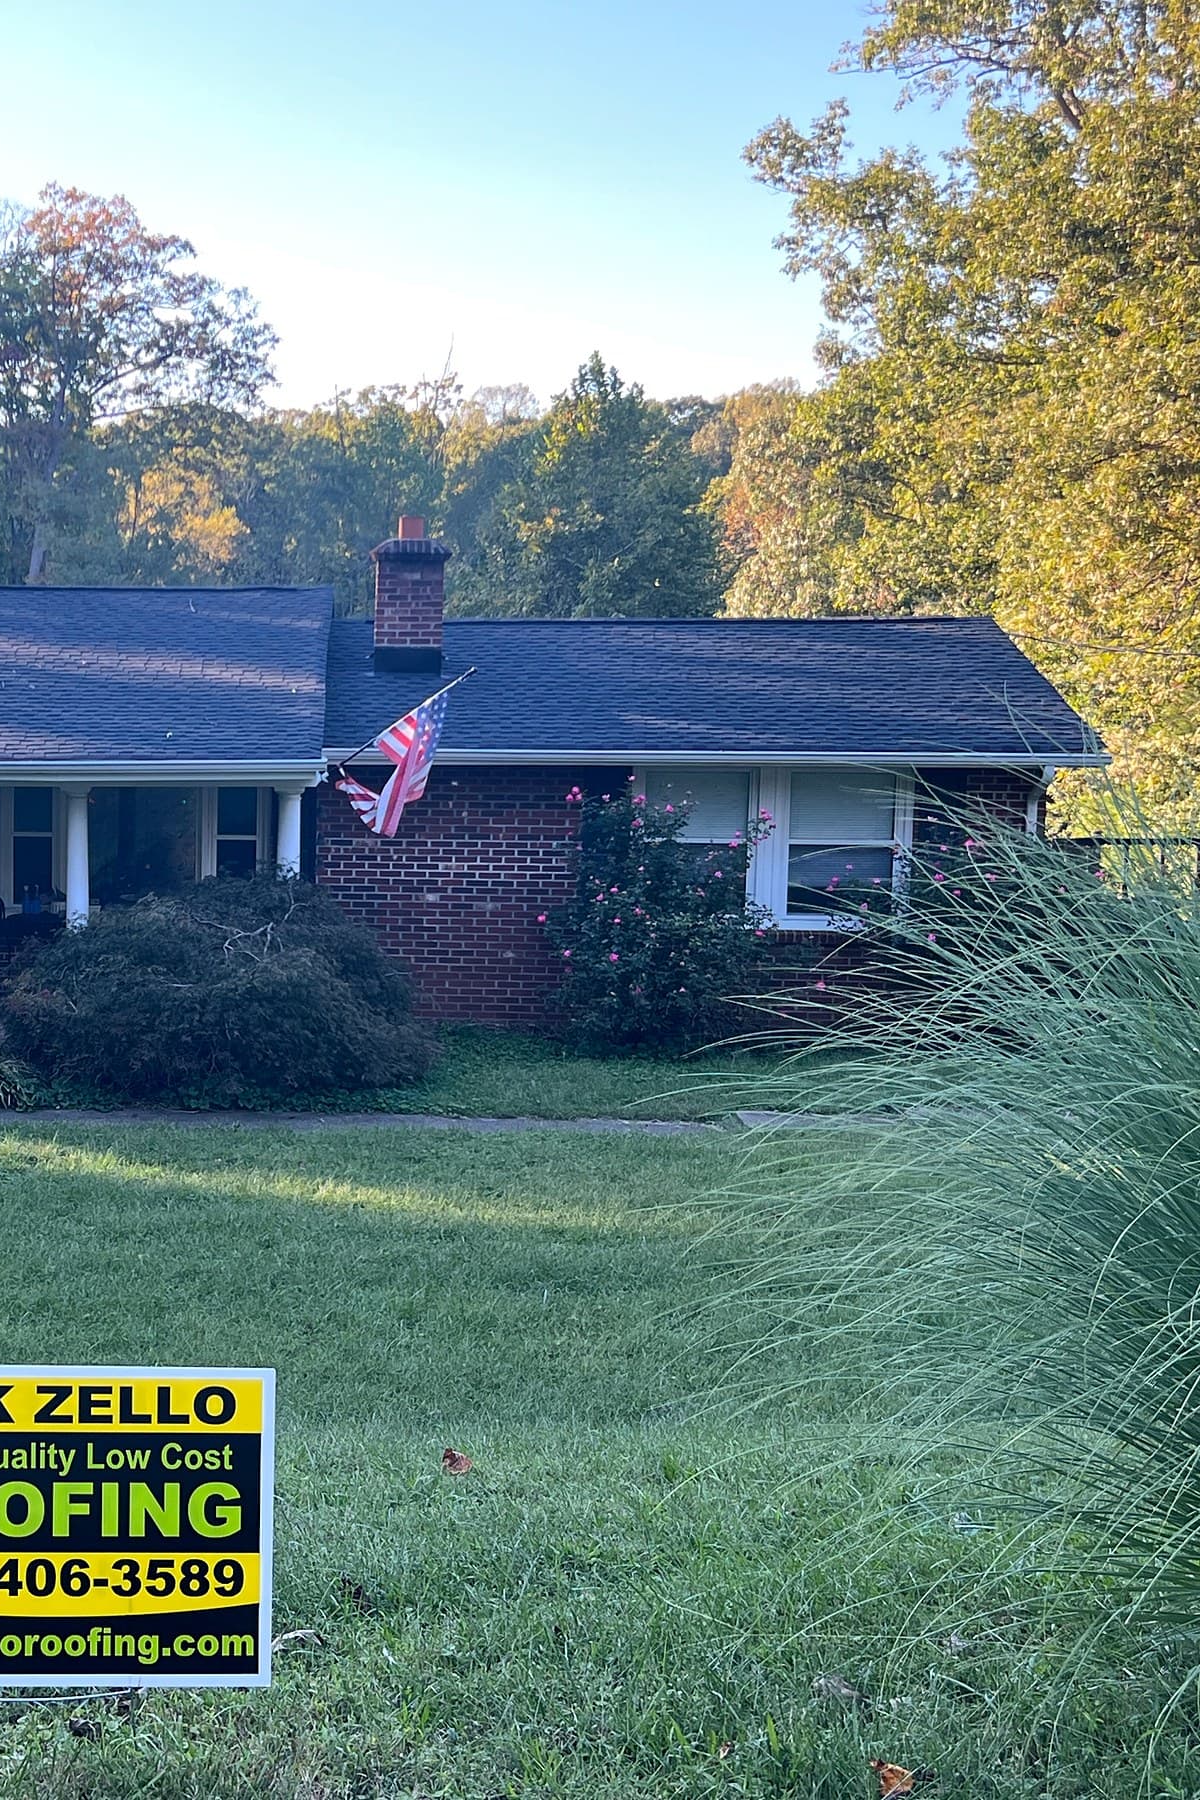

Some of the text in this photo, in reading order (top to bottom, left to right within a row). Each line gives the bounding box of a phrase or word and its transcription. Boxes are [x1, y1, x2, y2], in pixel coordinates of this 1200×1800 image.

[34, 1385, 237, 1424] ZELLO
[87, 1443, 151, 1470] Low
[161, 1443, 233, 1470] Cost
